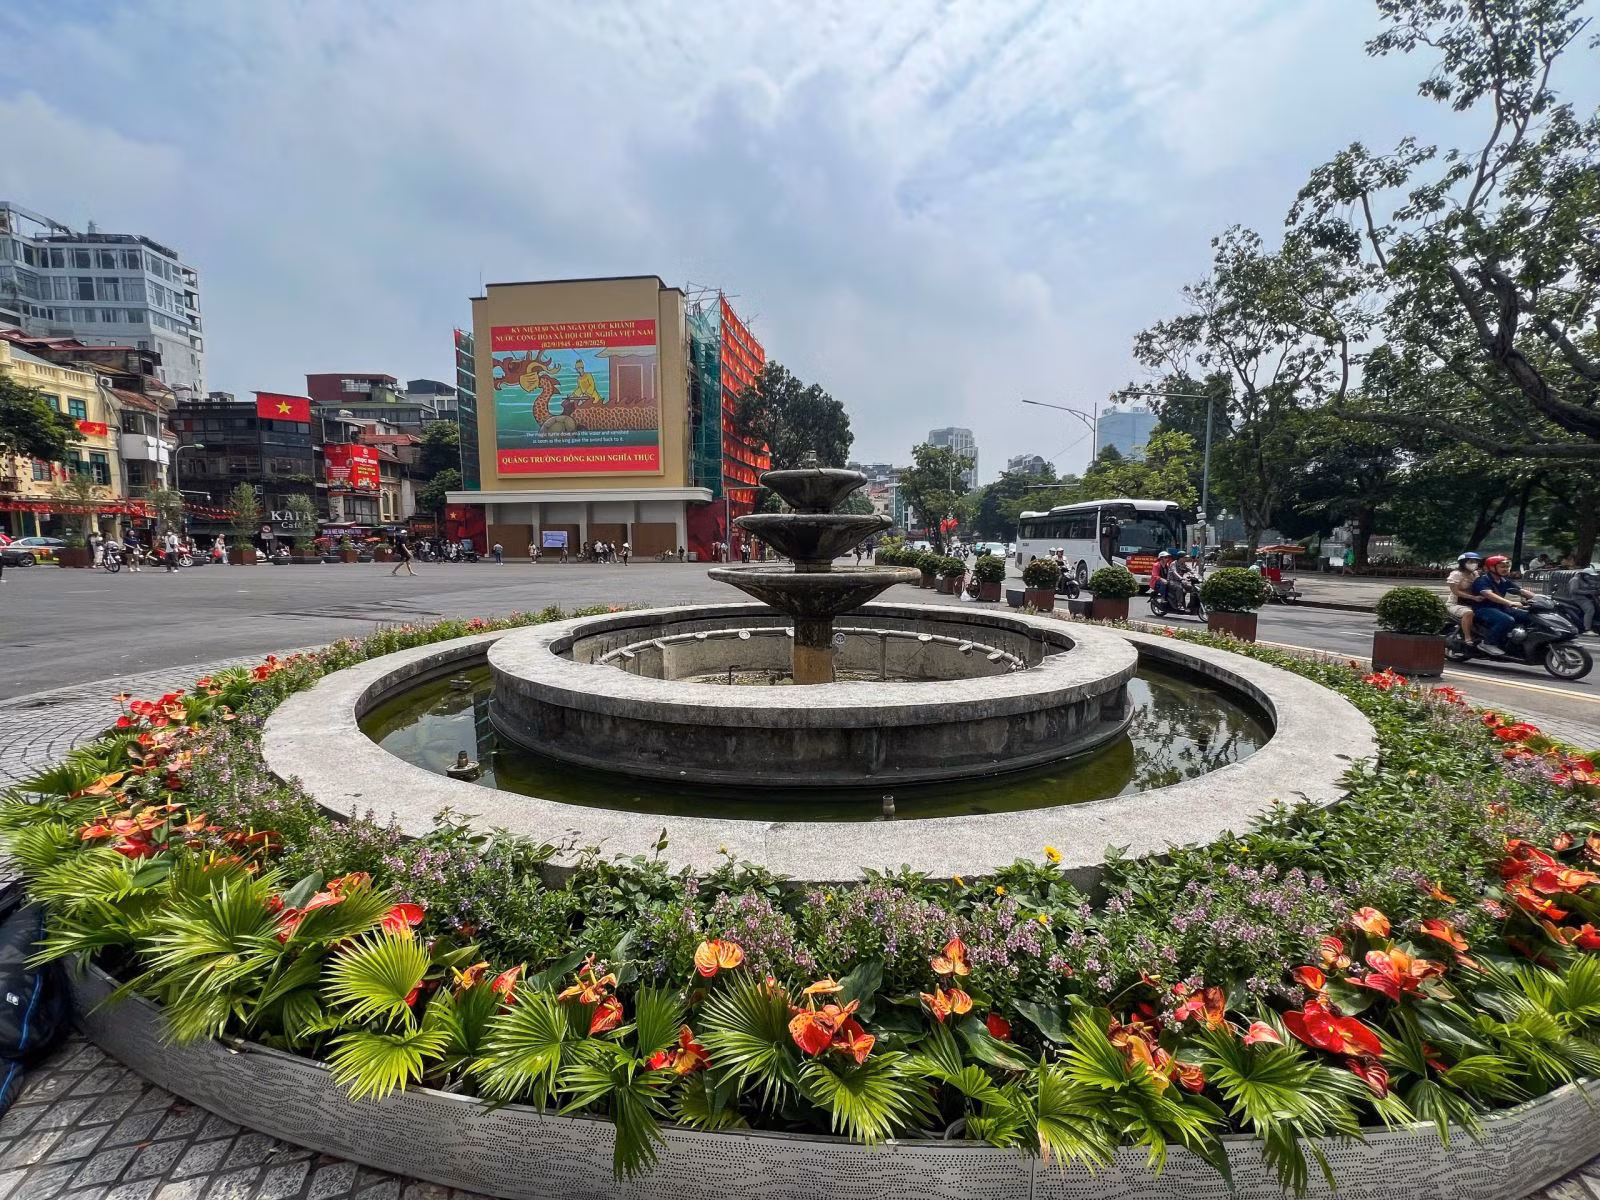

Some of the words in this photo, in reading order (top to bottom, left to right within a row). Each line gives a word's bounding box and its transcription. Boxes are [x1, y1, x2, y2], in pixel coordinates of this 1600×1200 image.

[502, 455, 528, 464] QUẢNG
[563, 454, 585, 462] ĐÔNG
[607, 453, 632, 461] NGHĨA
[633, 453, 655, 462] THỤC
